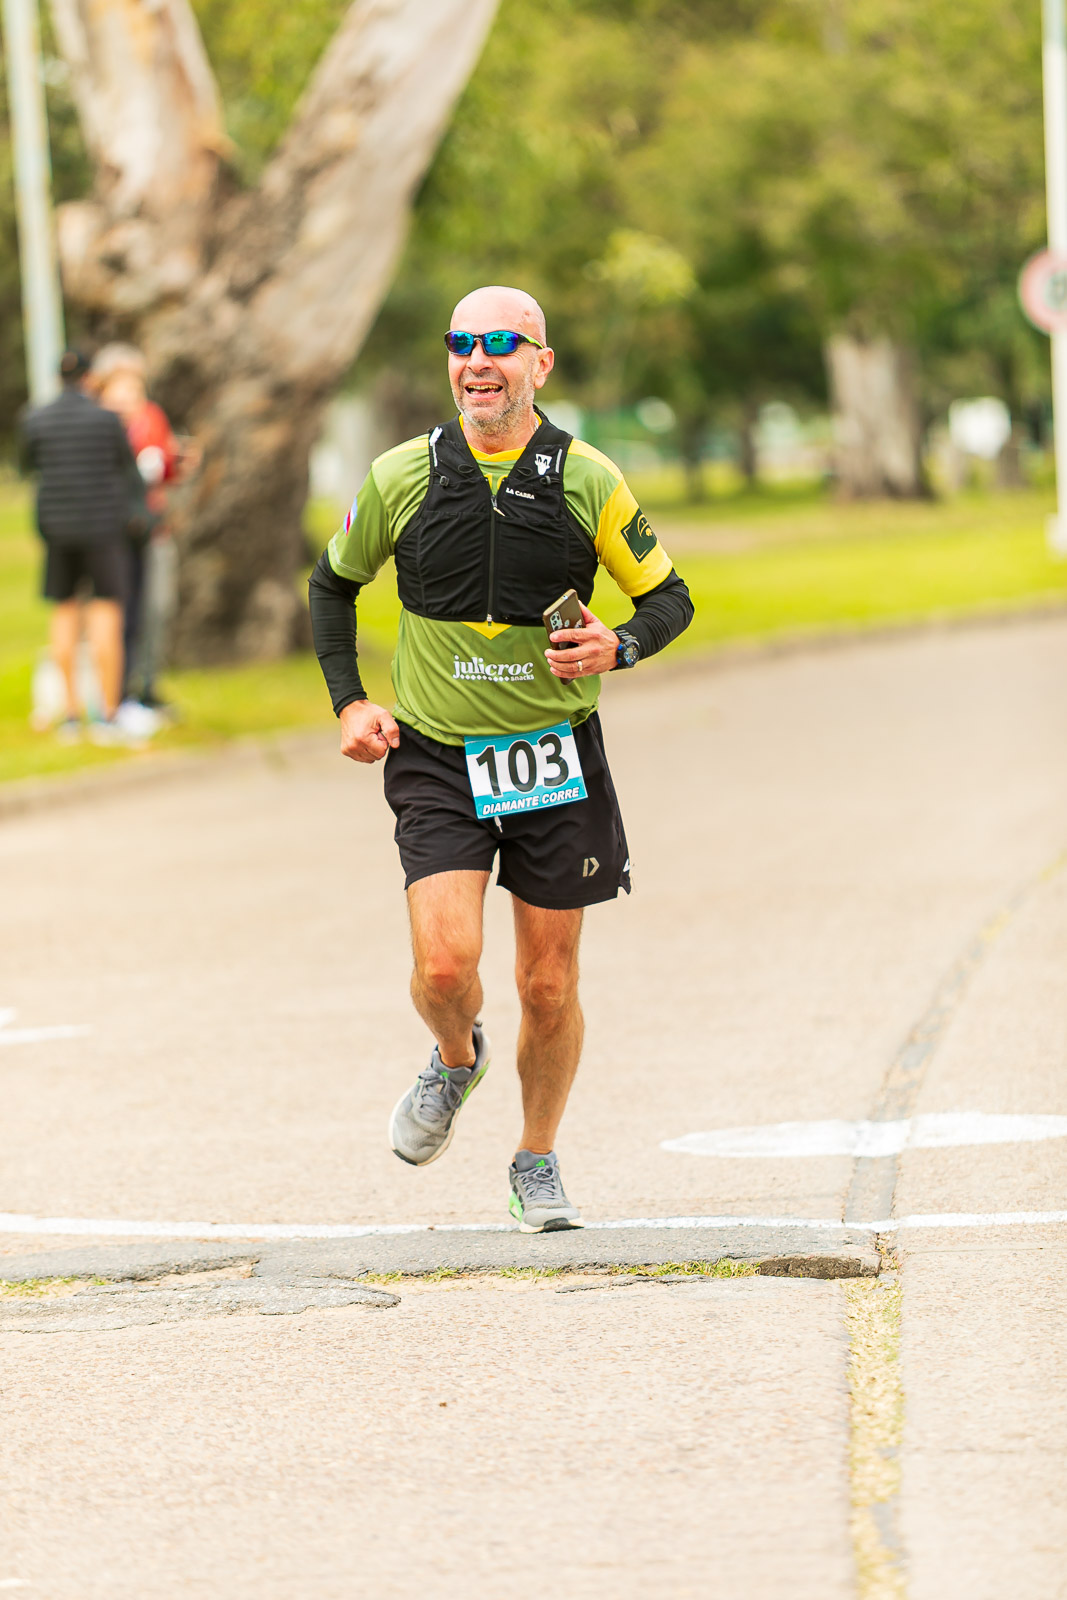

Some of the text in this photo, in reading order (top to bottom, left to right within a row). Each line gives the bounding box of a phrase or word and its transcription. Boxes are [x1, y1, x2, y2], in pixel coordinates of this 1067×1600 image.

[505, 487, 515, 495] LA
[452, 654, 534, 679] julicroc
[510, 674, 535, 682] snacks
[475, 732, 570, 798] 103
[482, 787, 580, 815] DIAMANTE CORRE
